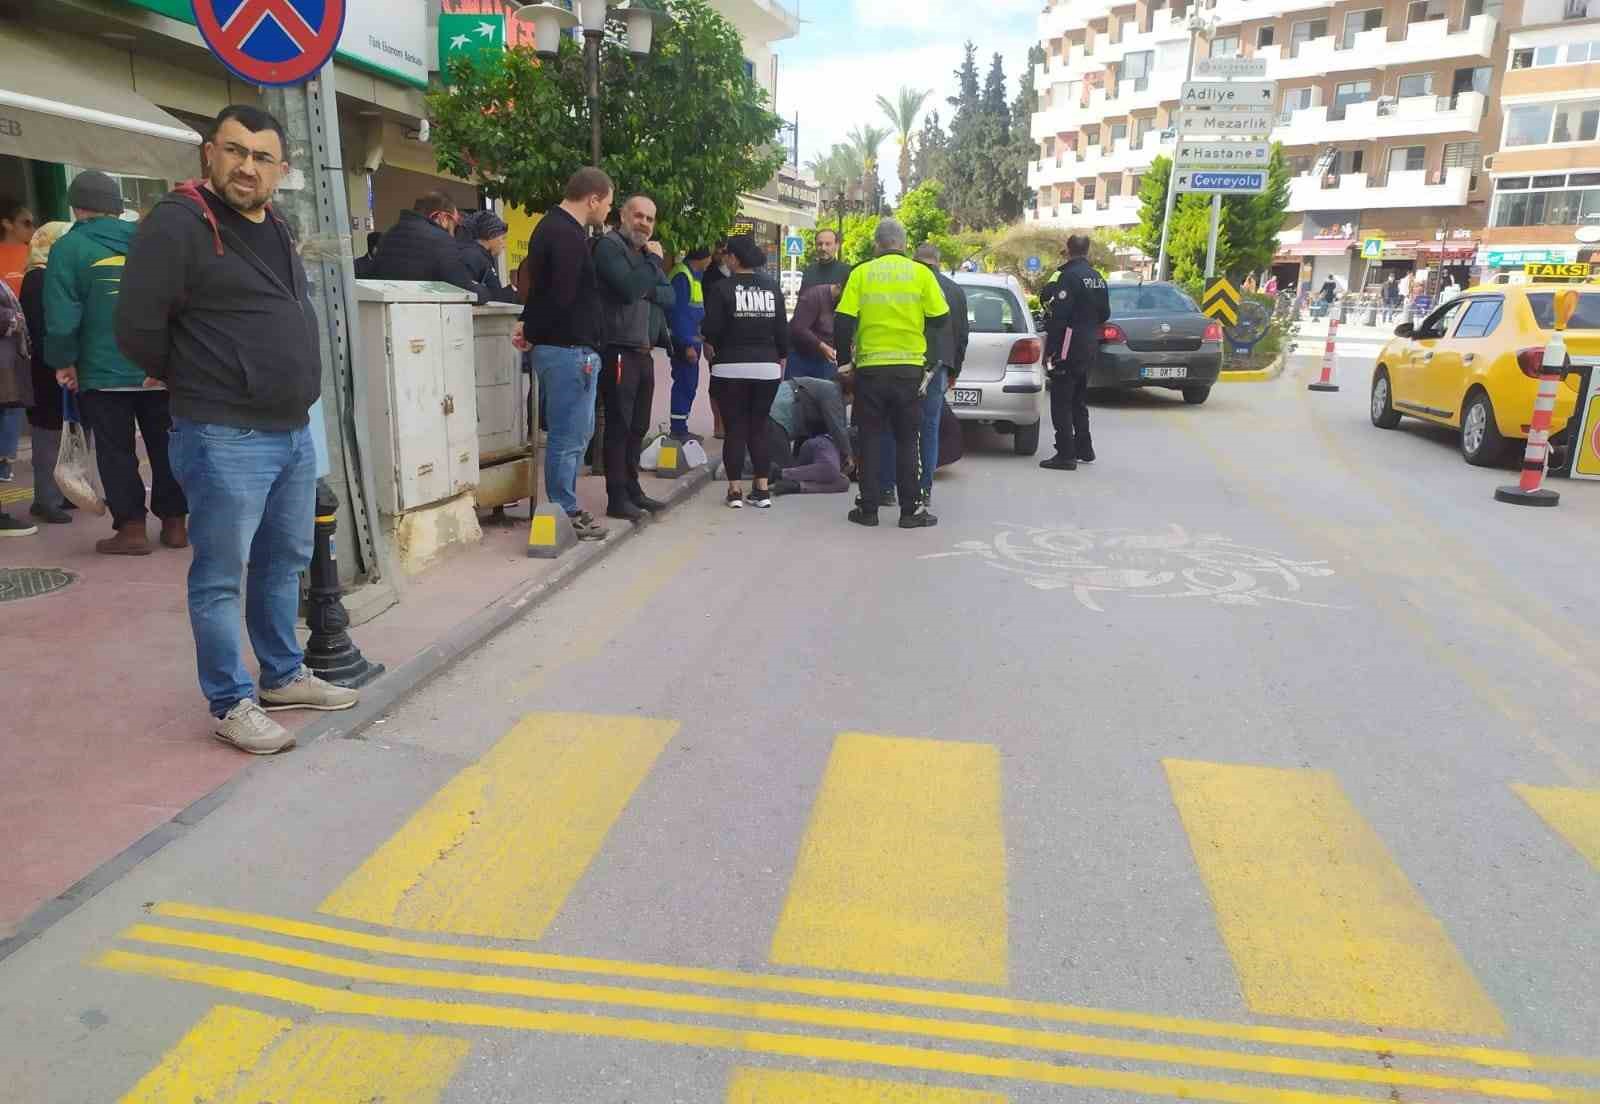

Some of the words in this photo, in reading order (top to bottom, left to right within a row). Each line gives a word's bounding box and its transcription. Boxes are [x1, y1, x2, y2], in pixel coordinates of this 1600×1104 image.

[1186, 87, 1235, 102] Adliye
[1194, 149, 1252, 159] Hastane
[735, 290, 775, 312] KING
[954, 391, 977, 402] 1922
